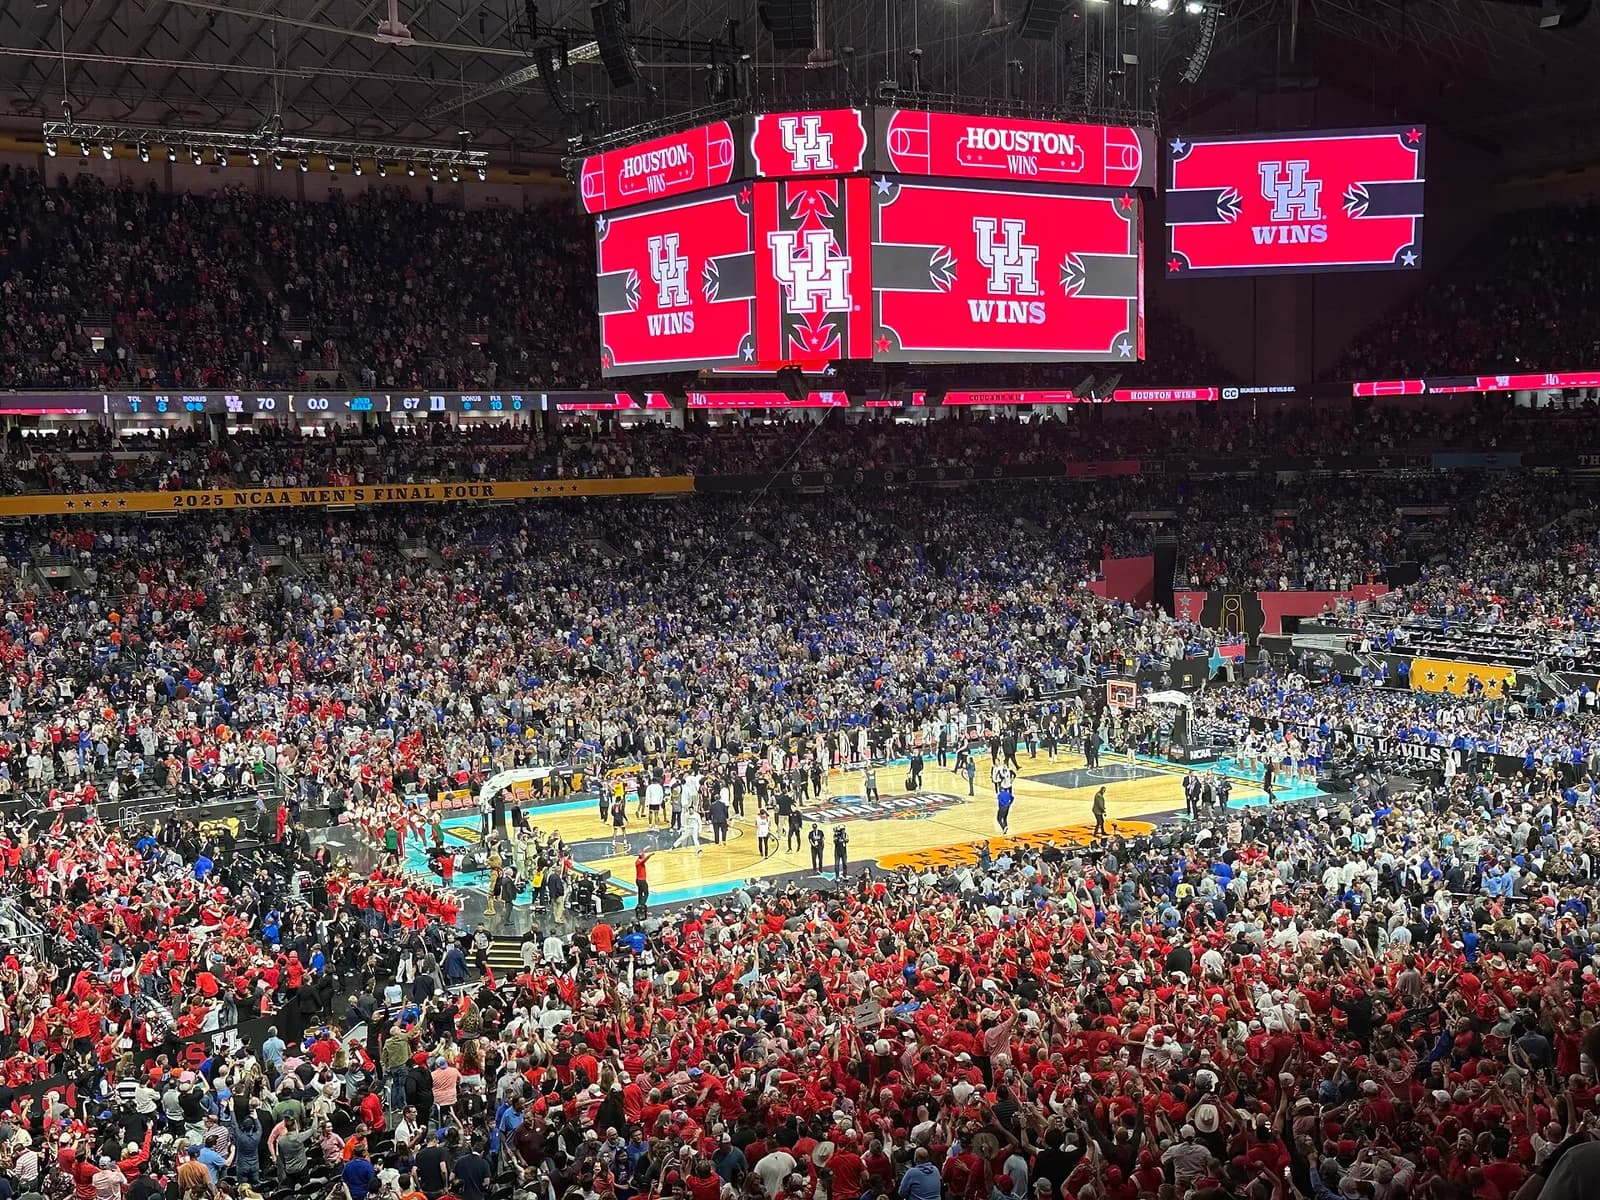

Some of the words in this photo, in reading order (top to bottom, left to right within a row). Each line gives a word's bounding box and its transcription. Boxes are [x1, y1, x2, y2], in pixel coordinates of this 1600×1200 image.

[966, 127, 1076, 155] HOUSTON
[623, 143, 689, 178] HOUSTON
[1006, 154, 1038, 176] WINS
[647, 173, 666, 194] WINS
[1251, 224, 1328, 245] WINS
[967, 299, 1046, 325] WINS
[647, 311, 695, 336] WINS
[257, 398, 275, 409] 70
[308, 398, 329, 409] 0.0
[403, 398, 420, 409] 67
[491, 401, 502, 410] 10
[513, 401, 521, 410] 0
[1131, 391, 1171, 400] HOUSTON
[1174, 391, 1197, 399] WINS
[131, 403, 138, 412] 1
[173, 494, 224, 507] 2025
[234, 492, 291, 505] NCAA
[300, 489, 365, 503] MEN'S
[374, 487, 435, 500] FINAL
[443, 485, 495, 498] FOUR
[1189, 749, 1212, 760] NCAA
[802, 803, 884, 821] FINAL
[881, 793, 953, 811] FOUR
